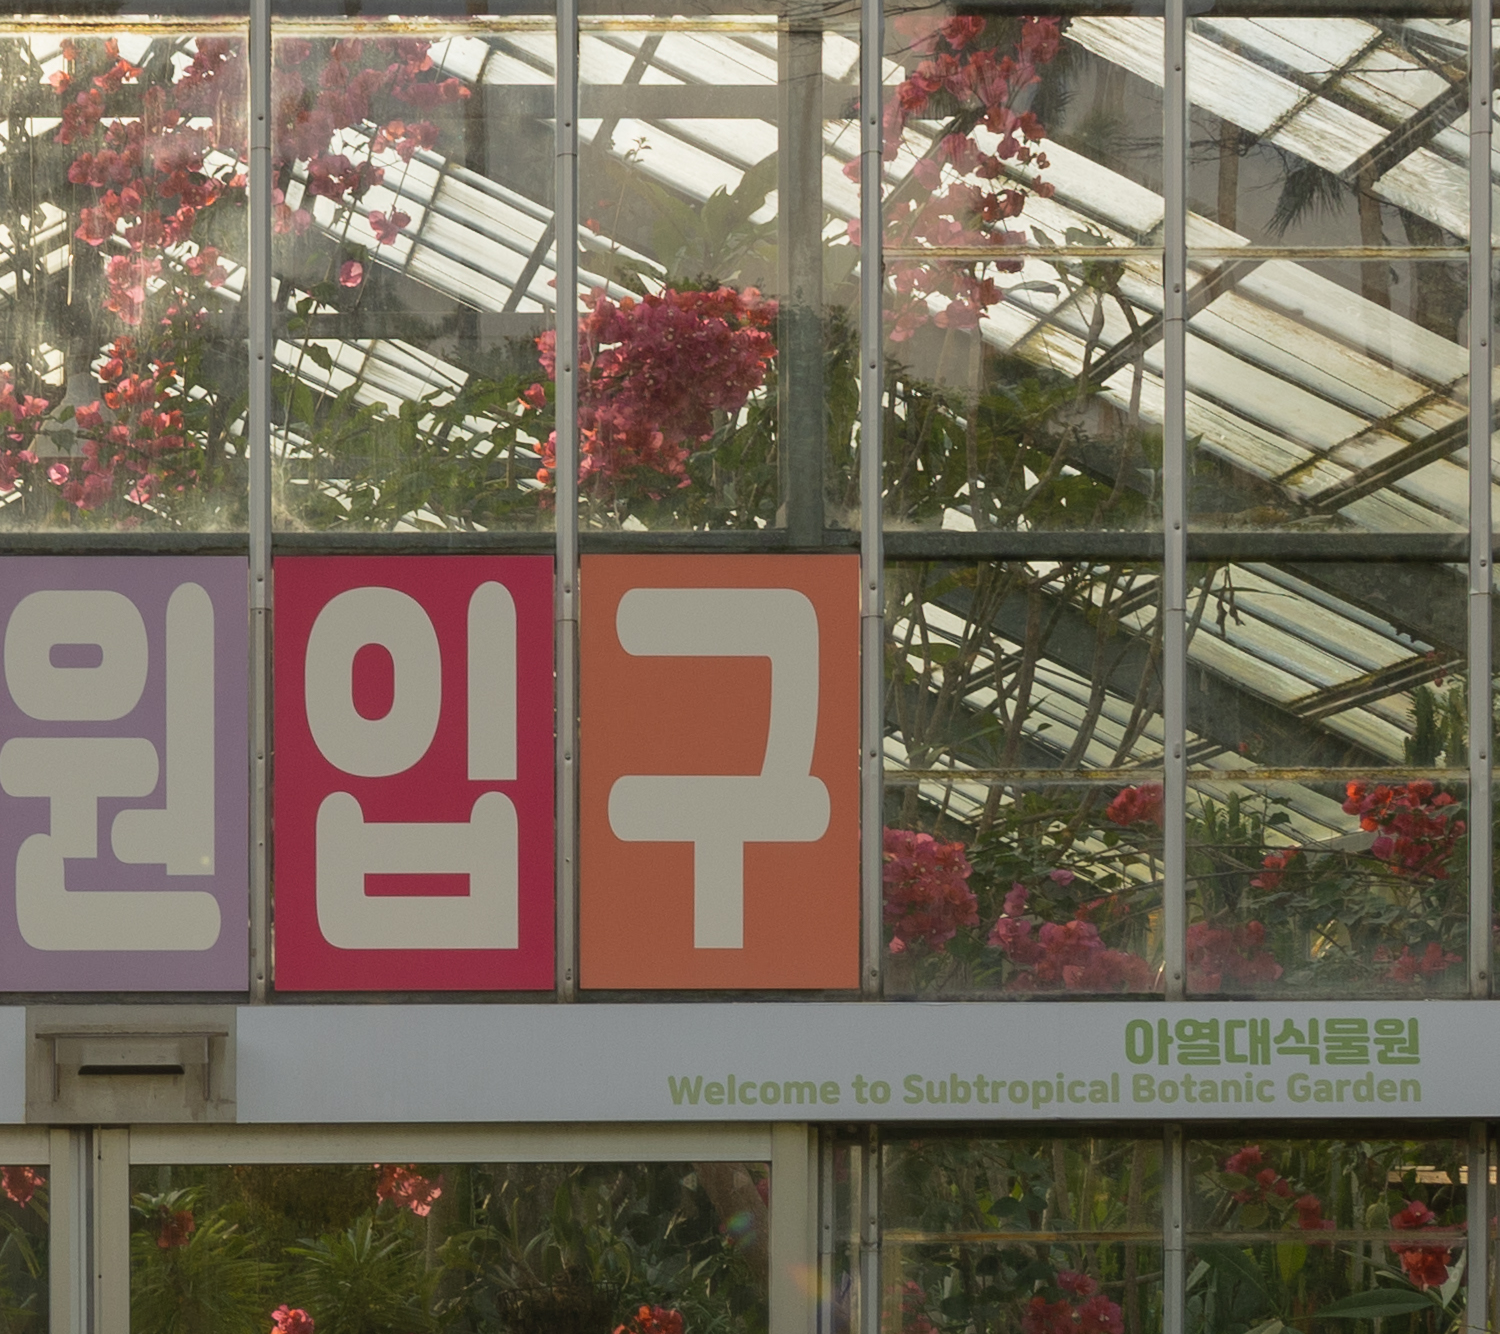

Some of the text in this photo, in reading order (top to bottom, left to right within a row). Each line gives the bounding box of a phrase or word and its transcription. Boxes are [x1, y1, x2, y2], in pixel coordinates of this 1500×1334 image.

[1124, 1017, 1422, 1067] 아열대식물원
[667, 1070, 1423, 1110] Welcome to Subtropical Botanic Garden
